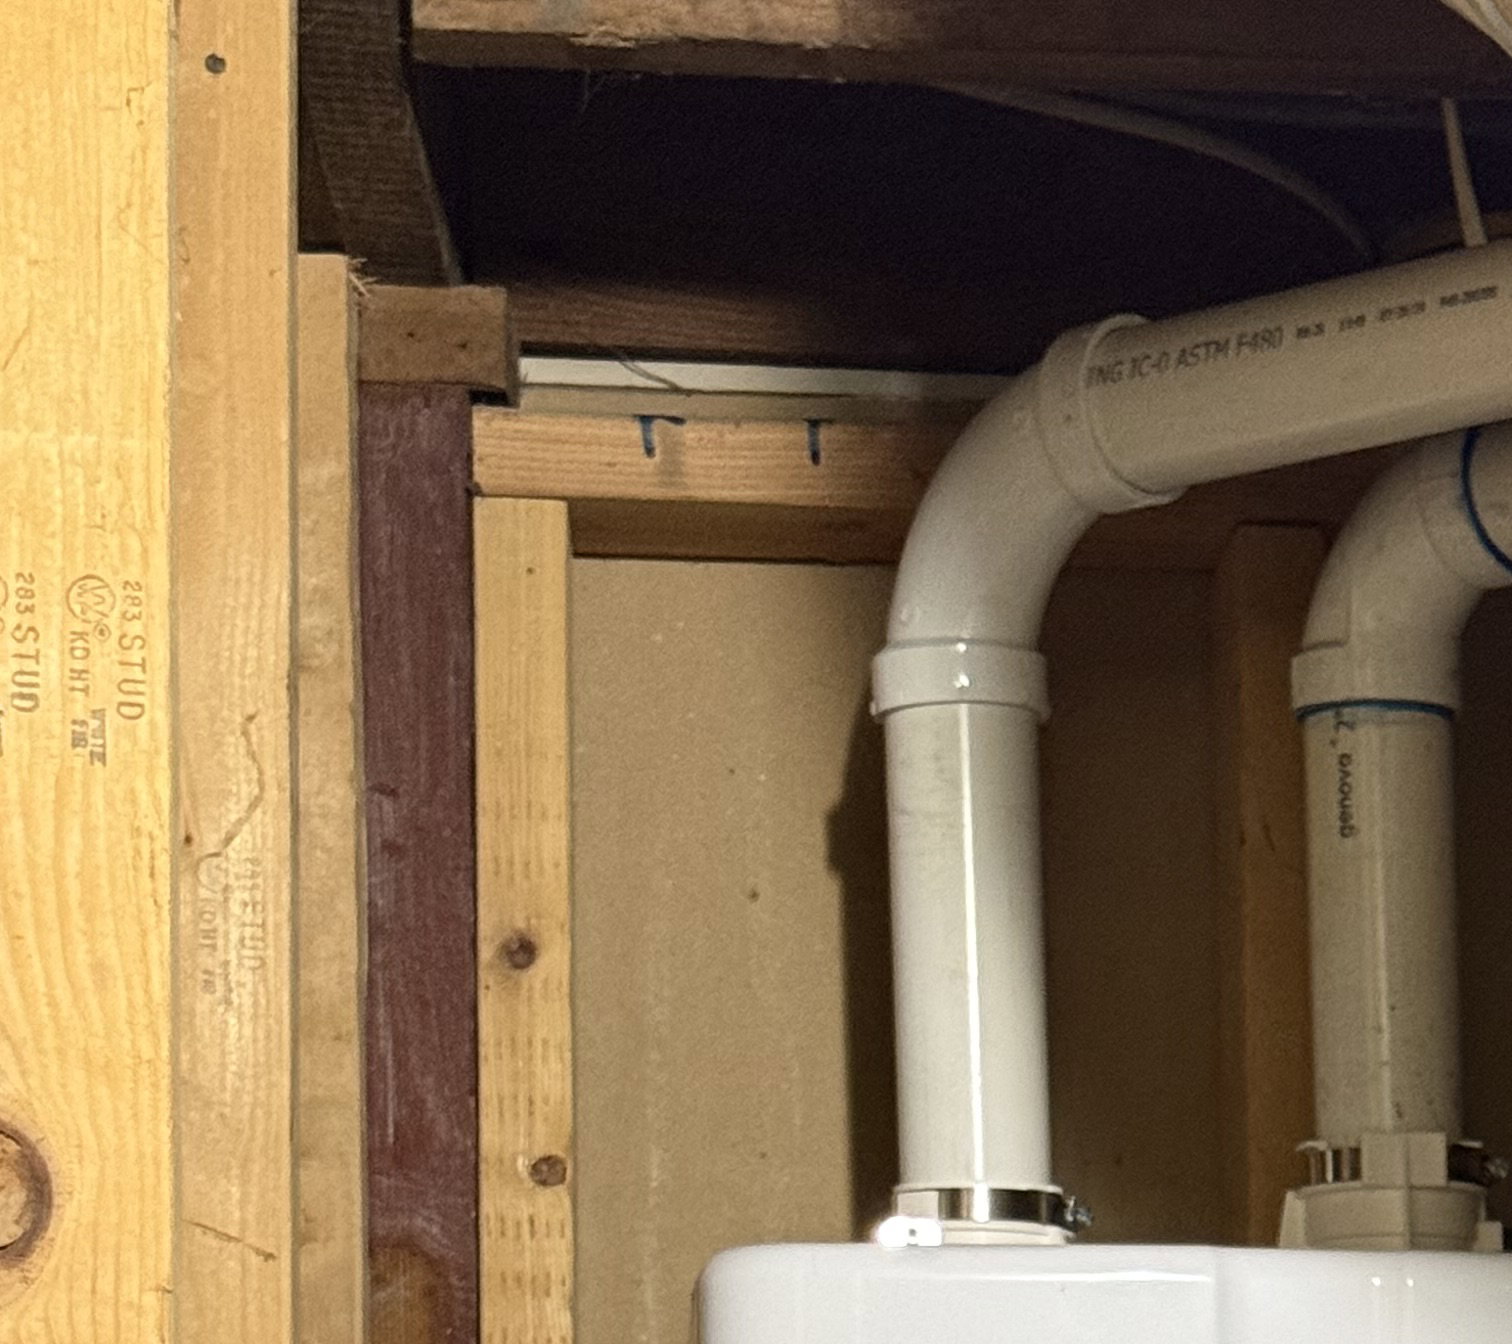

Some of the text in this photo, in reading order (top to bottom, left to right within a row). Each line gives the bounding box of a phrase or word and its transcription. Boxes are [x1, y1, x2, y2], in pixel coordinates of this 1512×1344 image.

[1176, 337, 1231, 370] ASTM
[1236, 325, 1284, 357] F480
[10, 572, 41, 713] 283 STUD
[69, 630, 91, 660] KD
[117, 580, 147, 720] 283 STUD
[68, 668, 91, 697] HT
[1338, 752, 1360, 838] genova
